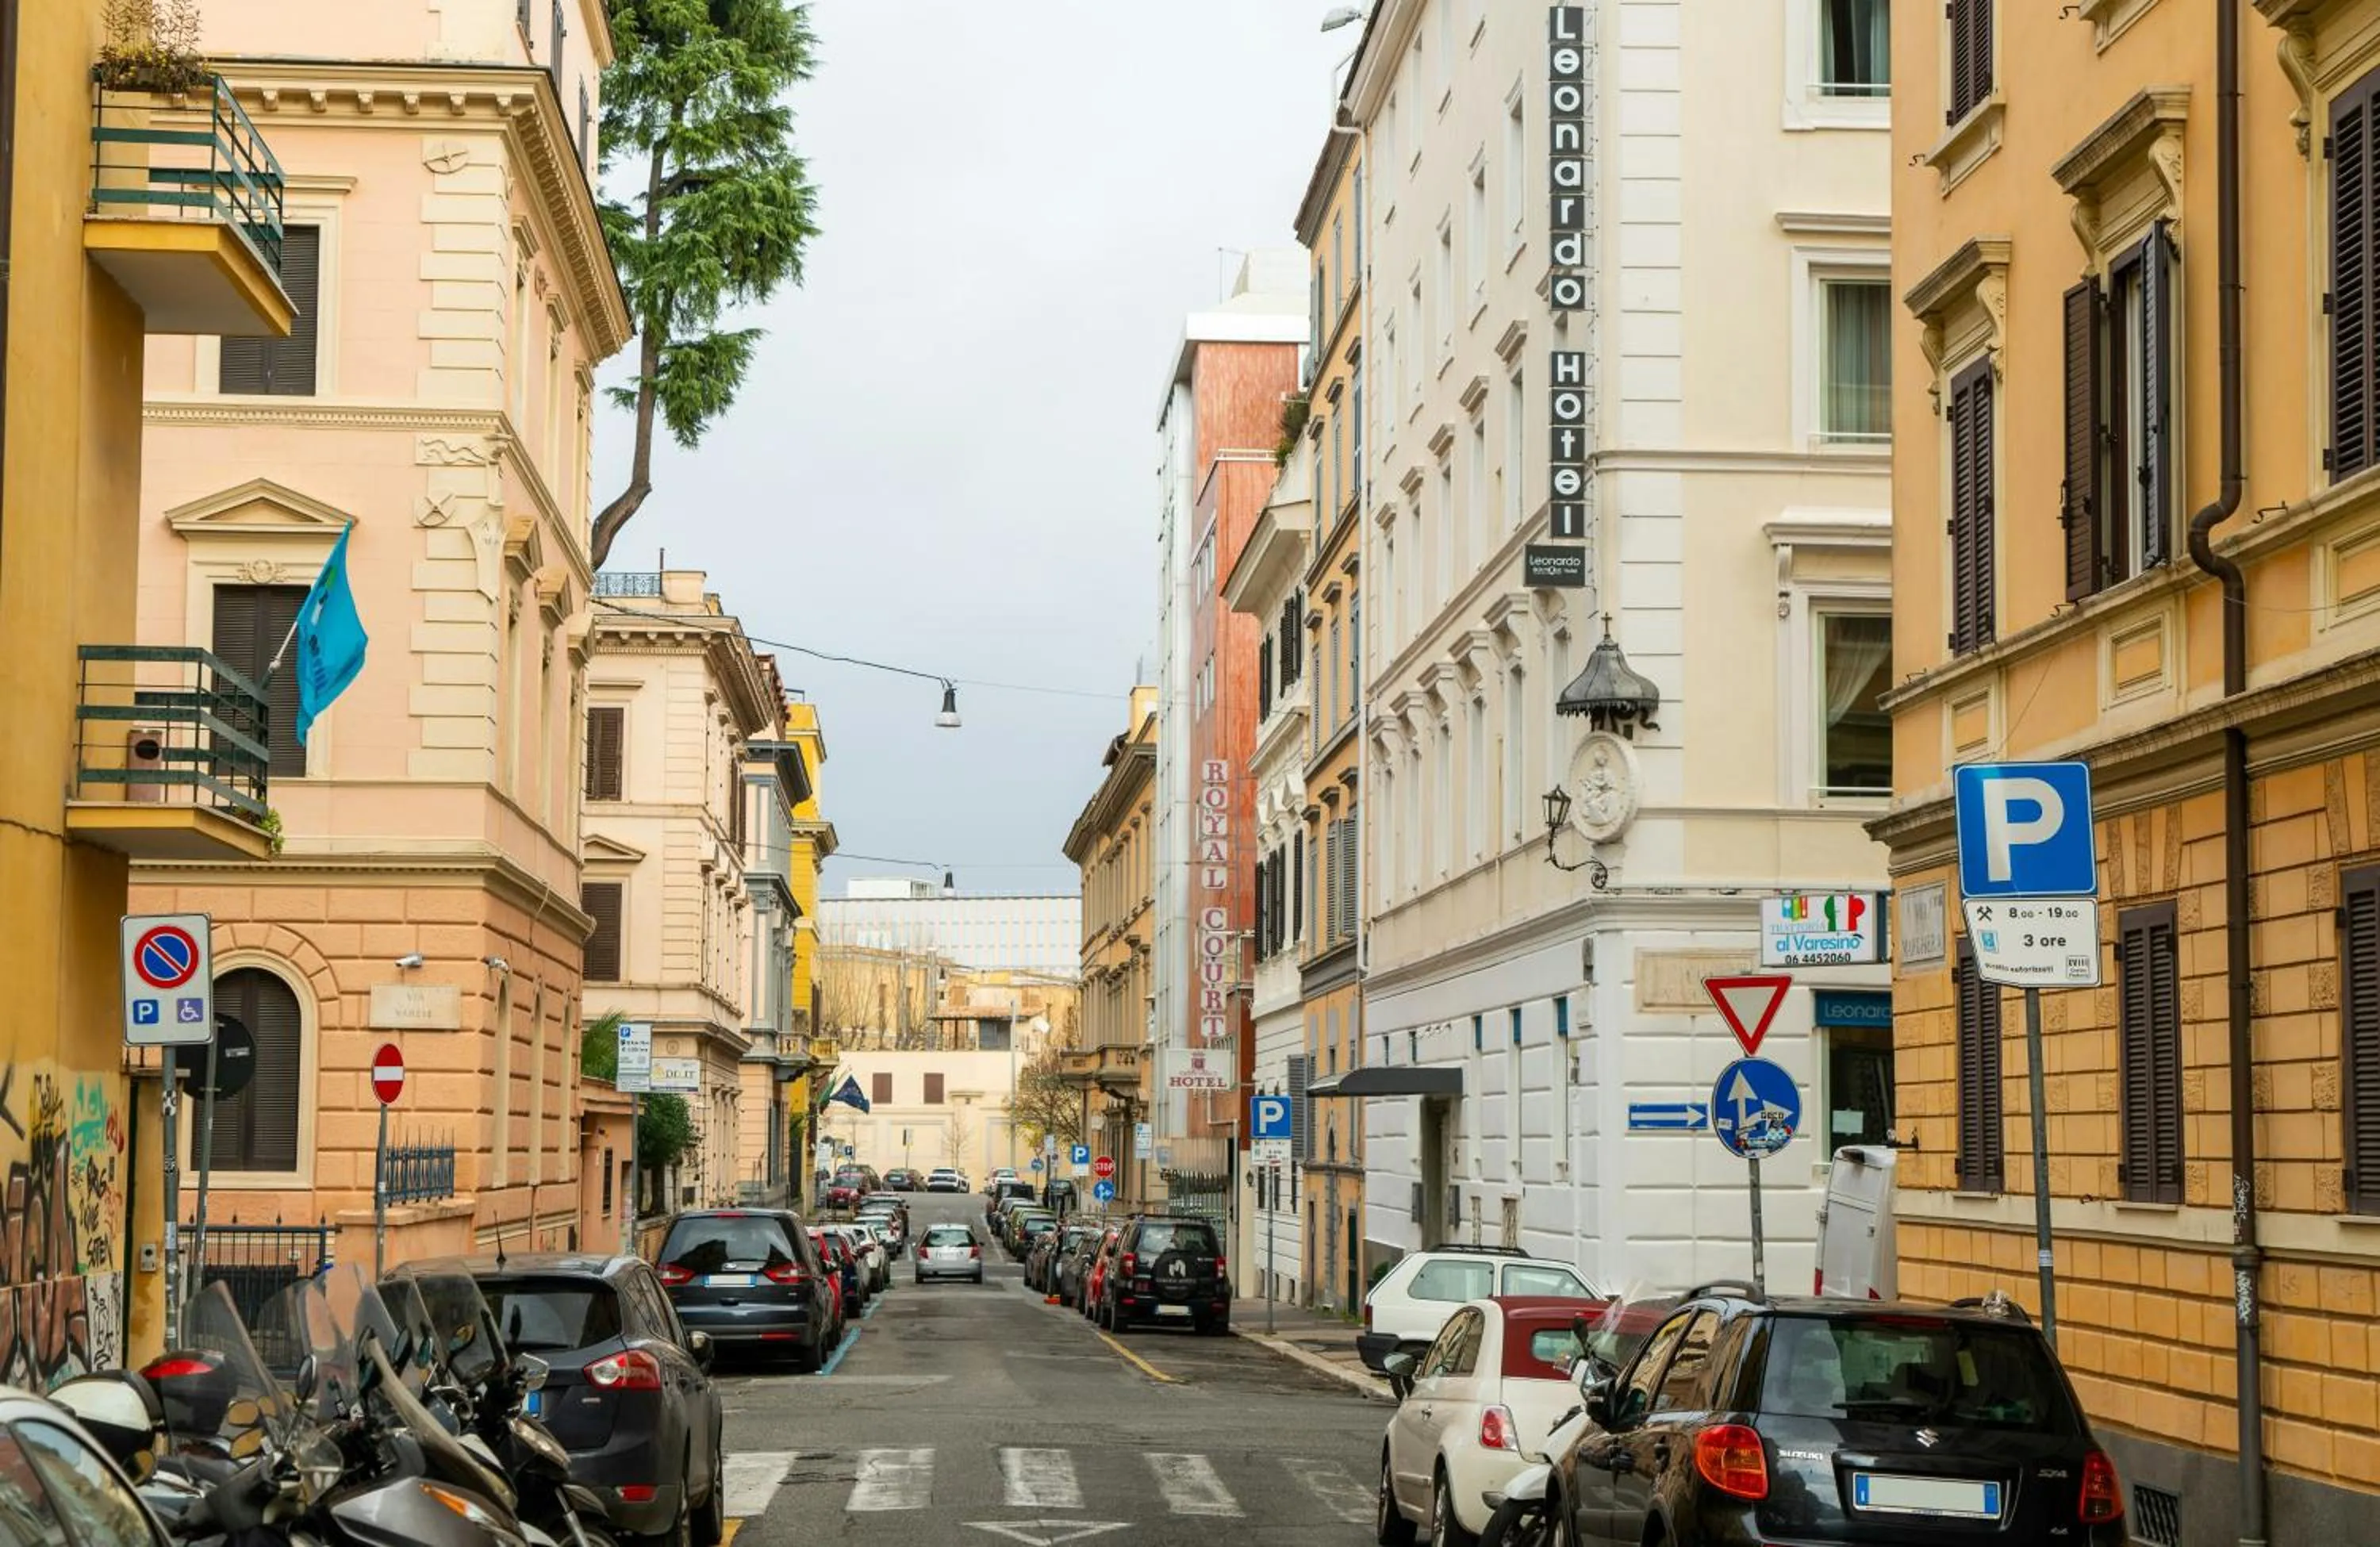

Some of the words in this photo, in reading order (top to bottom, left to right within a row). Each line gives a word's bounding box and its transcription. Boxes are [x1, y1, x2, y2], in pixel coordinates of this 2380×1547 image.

[1553, 7, 1583, 305] Leonardo
[1553, 354, 1582, 534] Hotel
[1529, 554, 1581, 566] Leonardo
[1205, 762, 1226, 889] ROYAL
[1983, 777, 2064, 883] P
[1776, 933, 1790, 952] al
[2023, 933, 2034, 947] 3
[2039, 936, 2067, 947] ore
[1784, 954, 1799, 965] 06
[1802, 952, 1852, 965] 4452060
[1203, 909, 1226, 1036] COURT
[138, 1003, 153, 1023] P
[1169, 1077, 1227, 1088] HOTEL
[1259, 1100, 1284, 1134] P
[1075, 1146, 1087, 1162] P
[1095, 1162, 1113, 1171] STOP
[1779, 1449, 1823, 1461] SUZUKI
